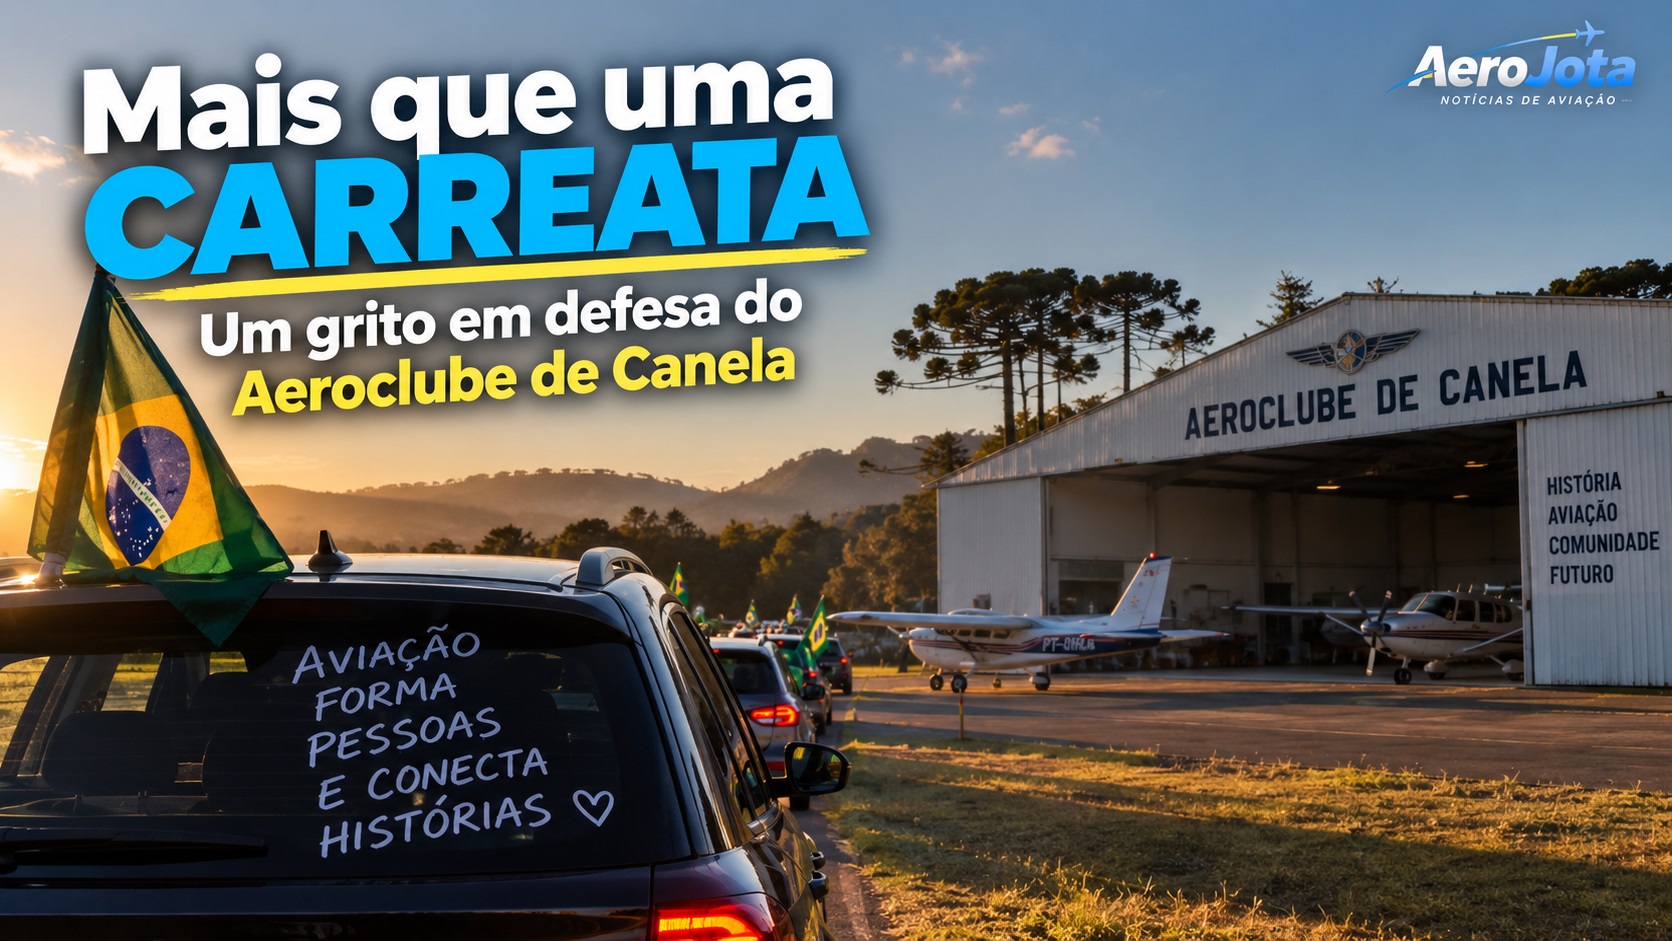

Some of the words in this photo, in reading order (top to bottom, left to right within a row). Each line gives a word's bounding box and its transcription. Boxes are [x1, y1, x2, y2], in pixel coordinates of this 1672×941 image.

[1185, 383, 1356, 440] AEROCLUBE
[1377, 374, 1420, 415] DE
[1439, 350, 1588, 405] CANELA
[1546, 470, 1622, 496] HISTÓRIA
[1548, 500, 1618, 526] AVIAÇÃO
[1549, 531, 1660, 555] COMUNIDADE
[1550, 564, 1614, 584] FUTURO
[292, 624, 480, 684] AVIAÇÃO
[316, 673, 457, 722] FORMA
[307, 707, 501, 768] PESSOAS
[318, 774, 346, 810] E
[367, 747, 549, 800] CONECTA
[319, 794, 552, 858] HISTÓRIAS
